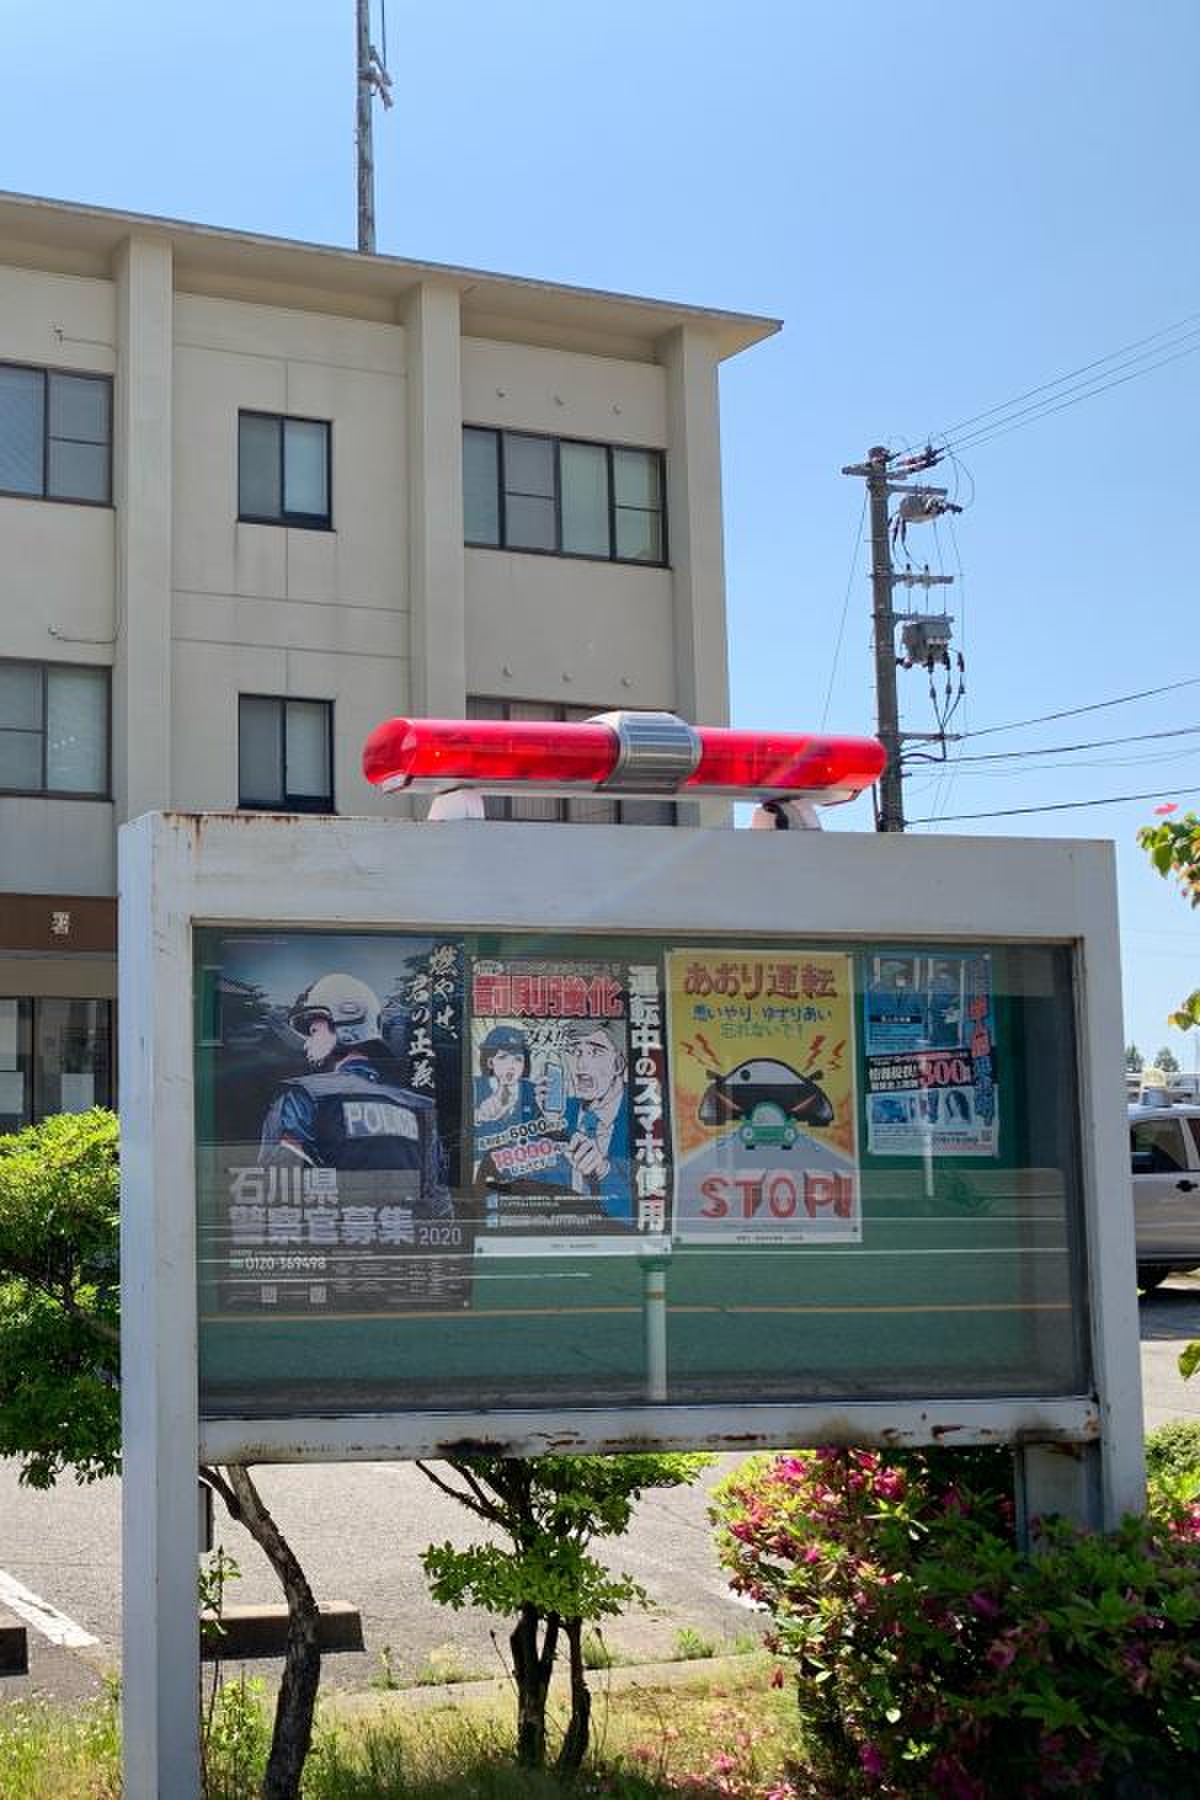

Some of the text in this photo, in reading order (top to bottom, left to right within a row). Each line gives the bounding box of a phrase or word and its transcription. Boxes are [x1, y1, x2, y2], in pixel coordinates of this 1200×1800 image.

[473, 975, 625, 1017] 罰則強化
[684, 961, 838, 1000] あおり運転
[405, 973, 436, 1089] 君の正義
[628, 965, 668, 1232] 運転中のスマホ使用
[228, 1168, 338, 1205] 石川県
[229, 1206, 462, 1245] 警察官募集 2020
